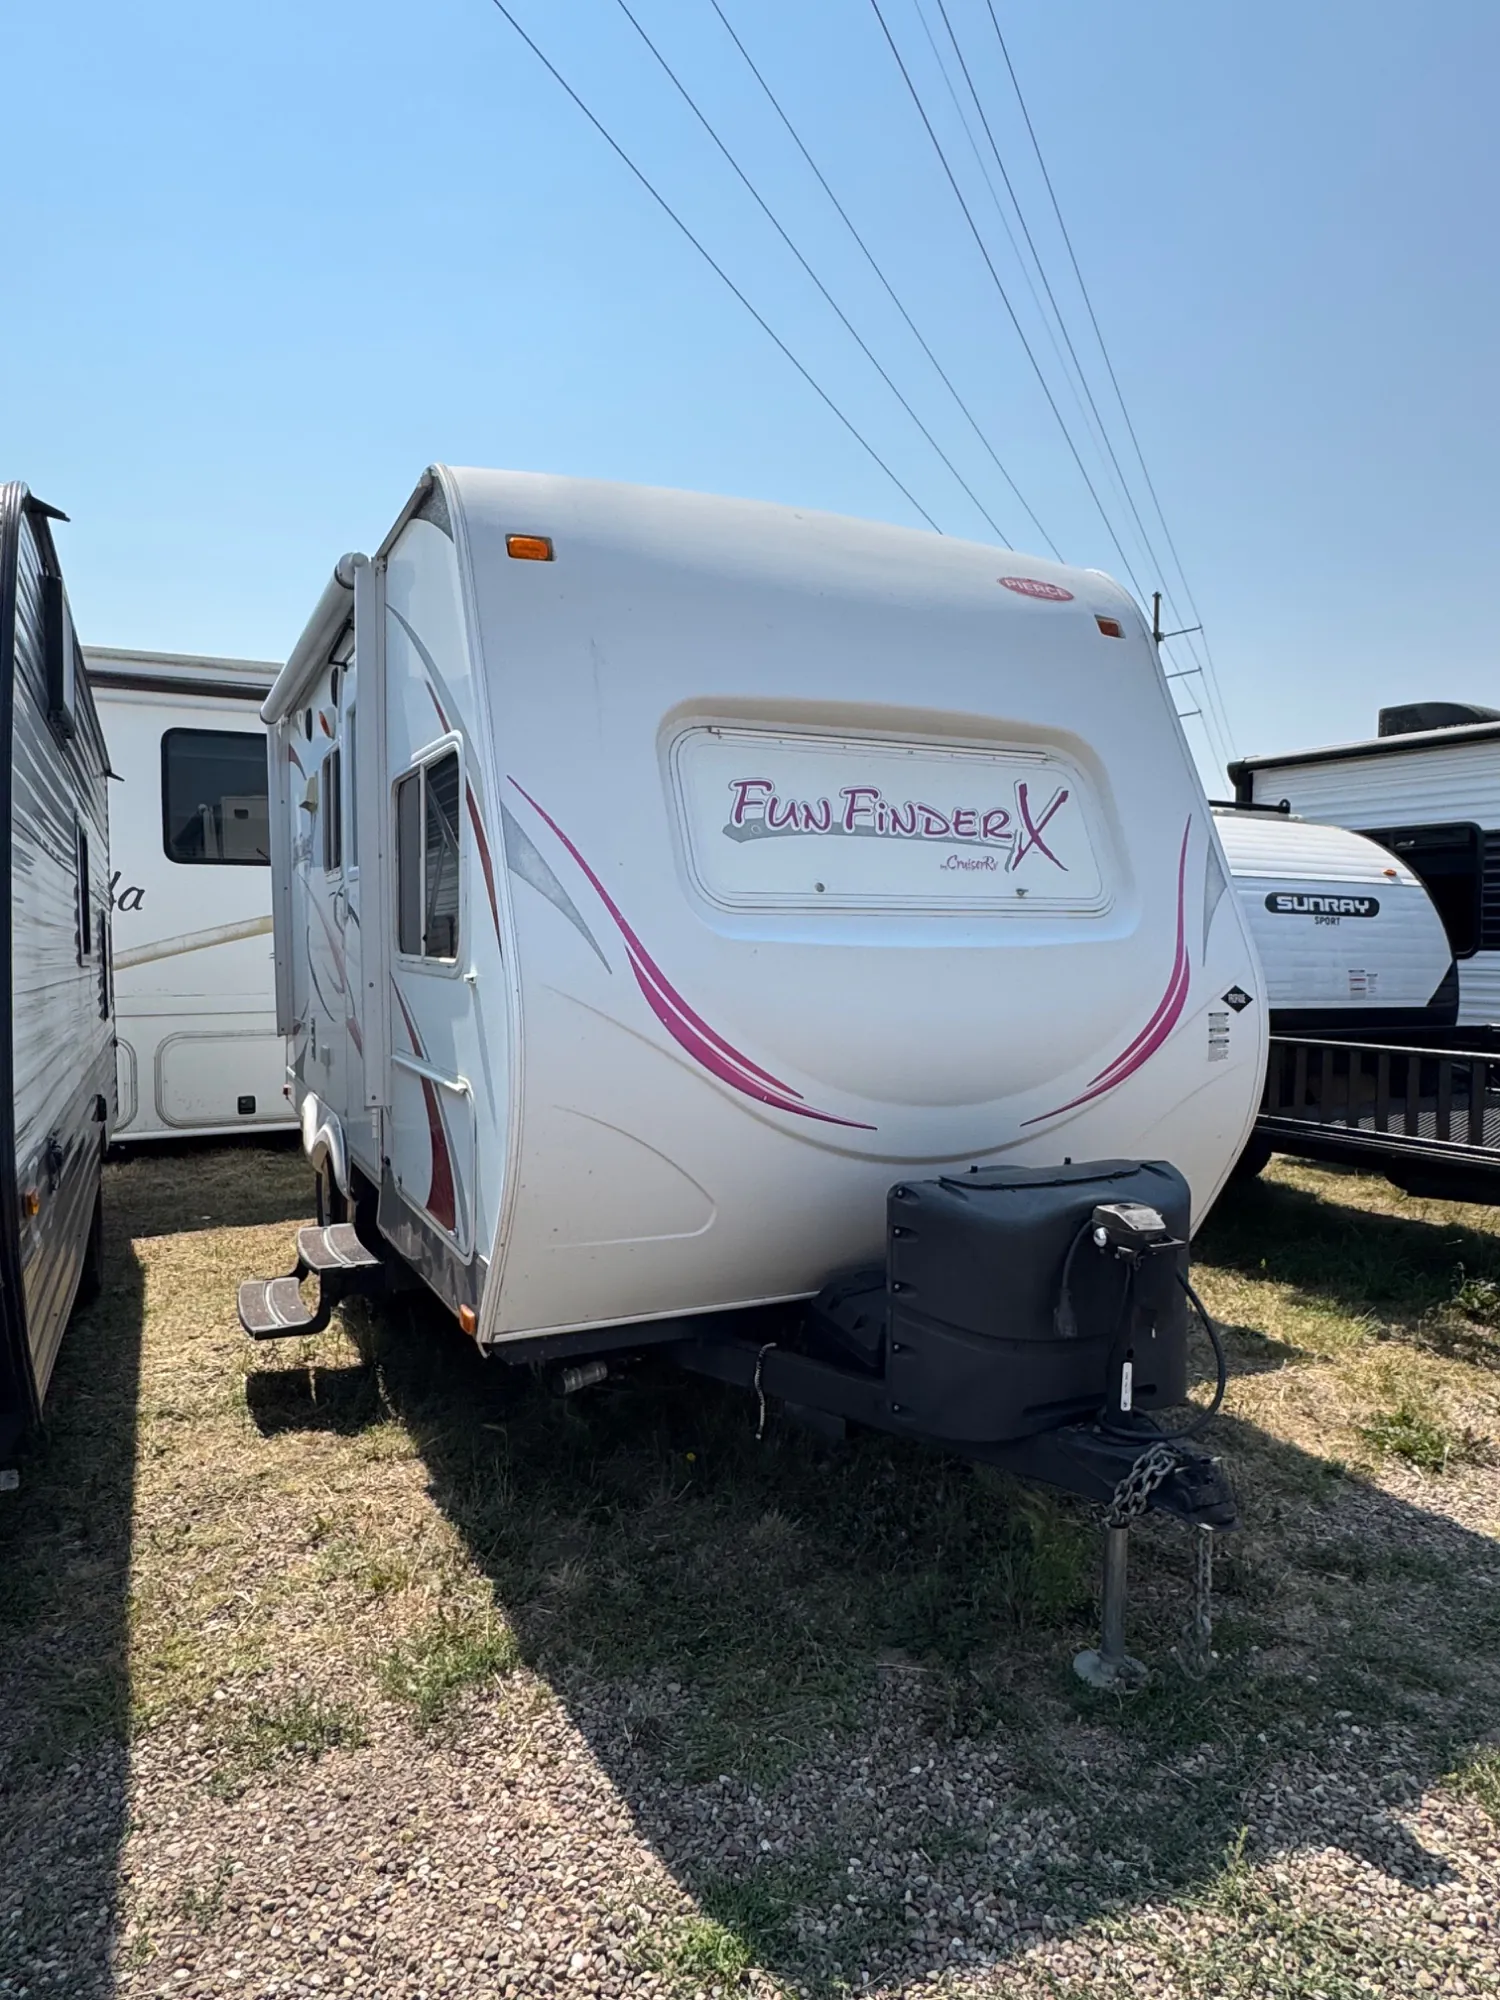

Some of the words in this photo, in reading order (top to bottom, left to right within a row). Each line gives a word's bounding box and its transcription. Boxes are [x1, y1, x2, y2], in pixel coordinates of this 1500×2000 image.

[1004, 579, 1069, 598] PIERCE
[730, 778, 832, 832] FUN
[1276, 895, 1370, 914] SUNRAY
[1314, 916, 1340, 926] SPORT
